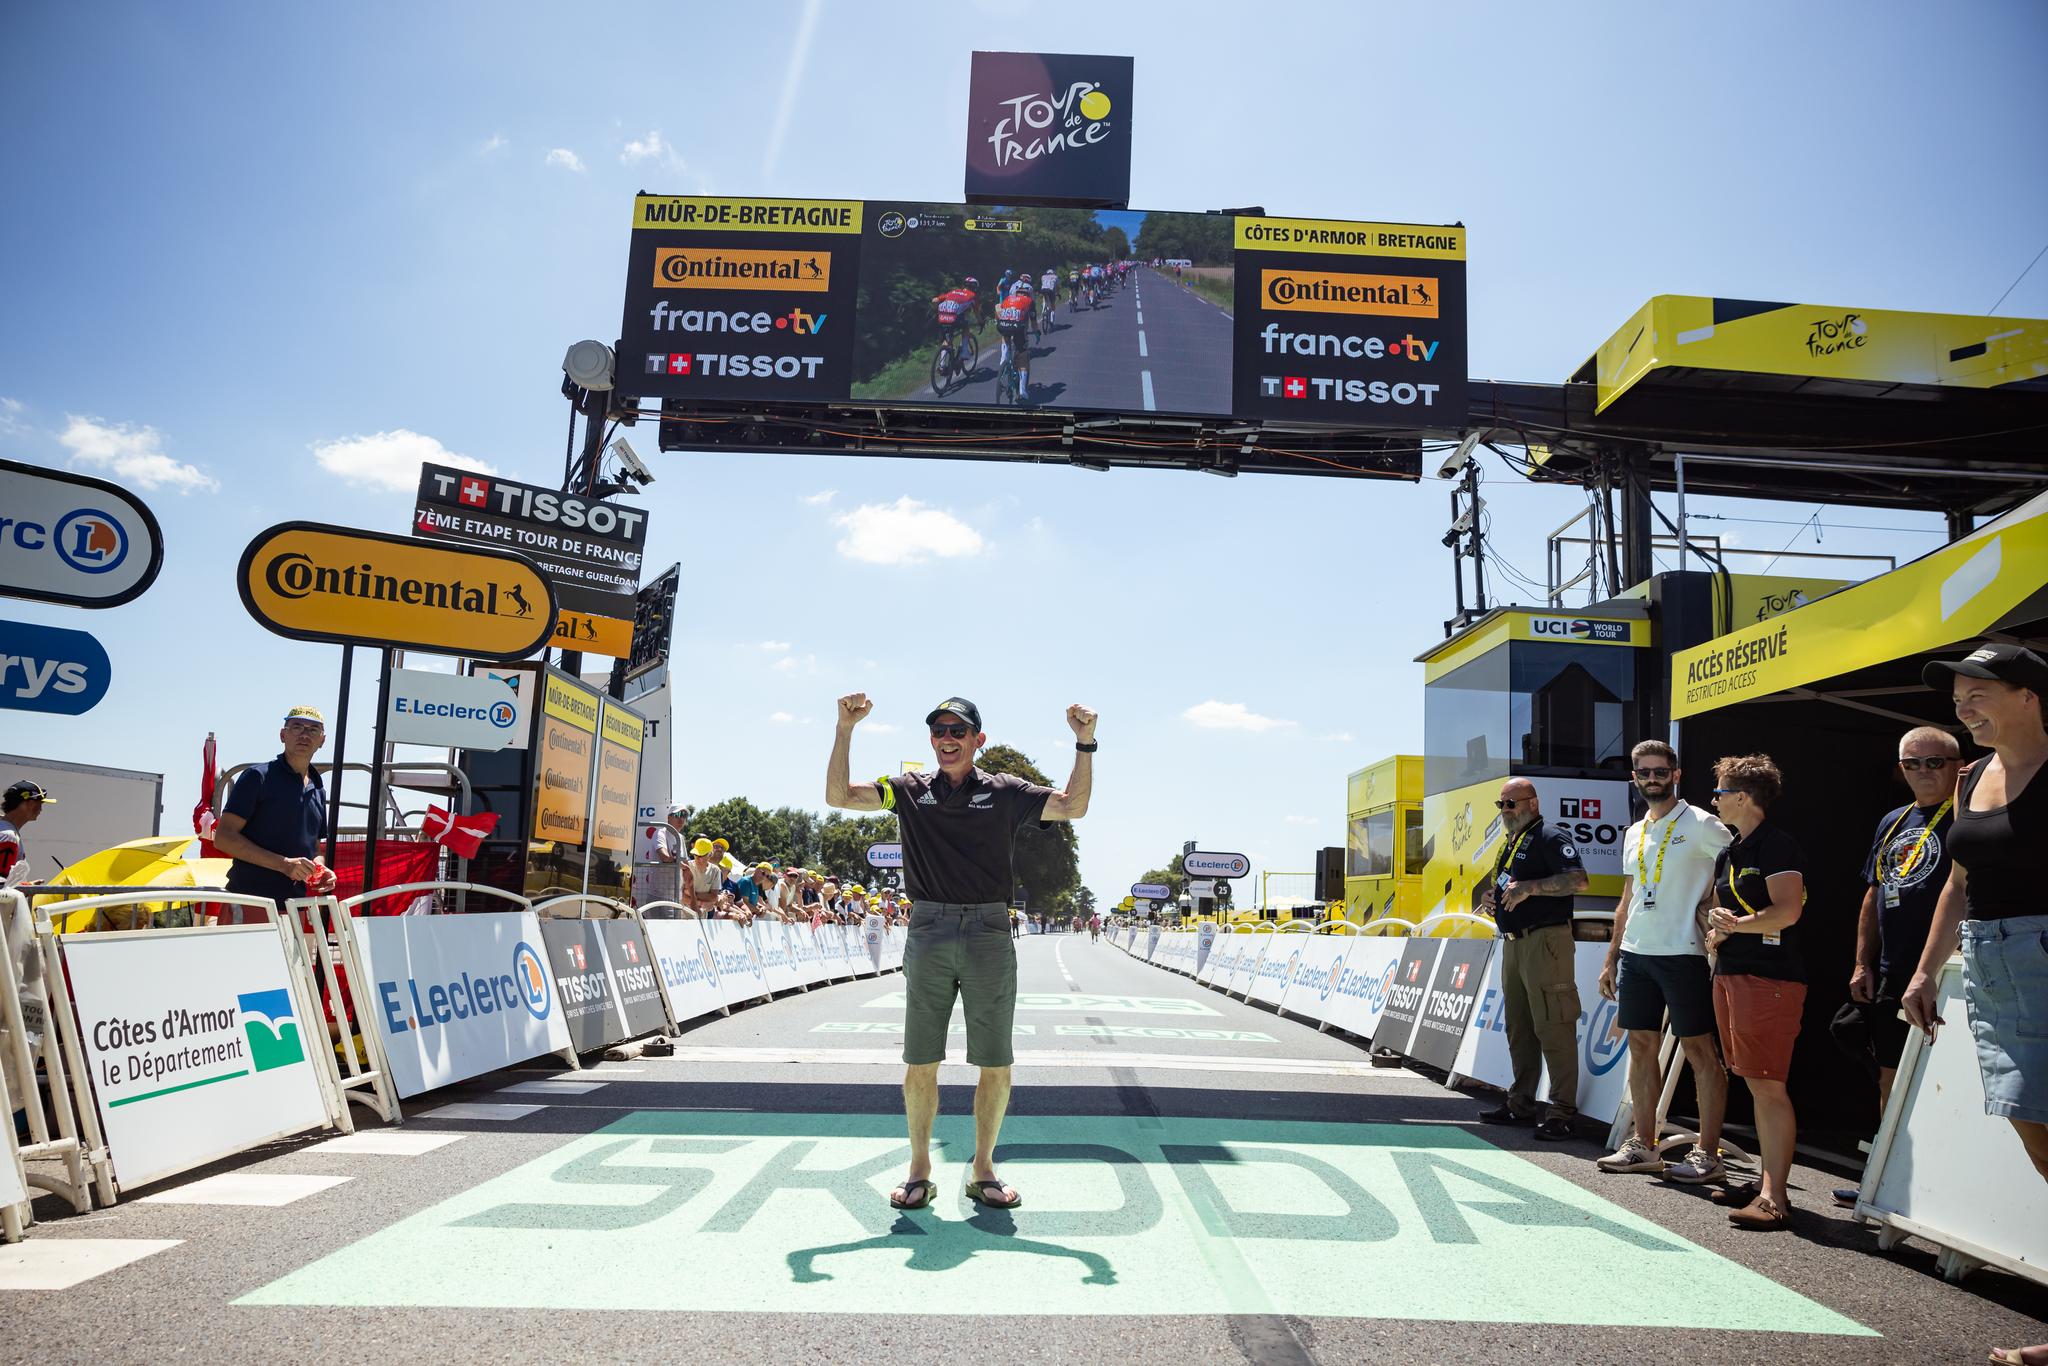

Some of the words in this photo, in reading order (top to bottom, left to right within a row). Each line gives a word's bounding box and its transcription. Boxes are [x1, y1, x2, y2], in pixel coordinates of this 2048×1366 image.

[1065, 112, 1082, 128] de
[645, 200, 851, 227] MÛR-DE-BRETAGNE
[1245, 224, 1290, 241] CÔTES
[1294, 229, 1366, 246] D'ARMOR
[1378, 233, 1457, 251] BRETAGNE
[662, 255, 800, 283] Continental
[1268, 276, 1410, 305] Continental
[696, 354, 823, 378] TISSOT
[1311, 377, 1439, 406] TISSOT
[495, 483, 643, 539] TISSOT
[417, 508, 460, 531] 7ÈME
[465, 519, 512, 541] ETAPE
[517, 529, 557, 550] TOUR
[562, 538, 582, 554] DE
[585, 543, 642, 566] FRANCE
[266, 552, 498, 616] Continental
[536, 561, 585, 578] BRETAGNE
[586, 571, 639, 589] GUERLÉDAN
[1534, 620, 1567, 635] UCI
[1594, 623, 1623, 632] WORLD
[1595, 630, 1616, 639] TOUR
[1687, 649, 1723, 685] ACCÈS
[1726, 624, 1787, 673] RÉSERVÉ
[1687, 679, 1727, 704] RESTRICTED
[1728, 669, 1757, 694] ACCESS
[396, 697, 487, 721] E.Leclerc
[549, 728, 583, 755] Continental
[621, 721, 641, 742] BRETAGNE
[545, 768, 579, 792] Continental
[542, 808, 576, 830] Continental
[1188, 860, 1230, 869] E.Leclerc
[887, 876, 897, 885] 25
[1218, 886, 1228, 895] 25
[557, 972, 608, 1004] TISSOT
[616, 965, 656, 993] TISSOT
[379, 972, 519, 1035] E.Leclerc
[1388, 983, 1424, 1011] TISSOT
[1429, 990, 1474, 1022] TISSOT
[93, 1017, 157, 1052] Côtes
[102, 1060, 121, 1087] le
[128, 1036, 243, 1082] Département
